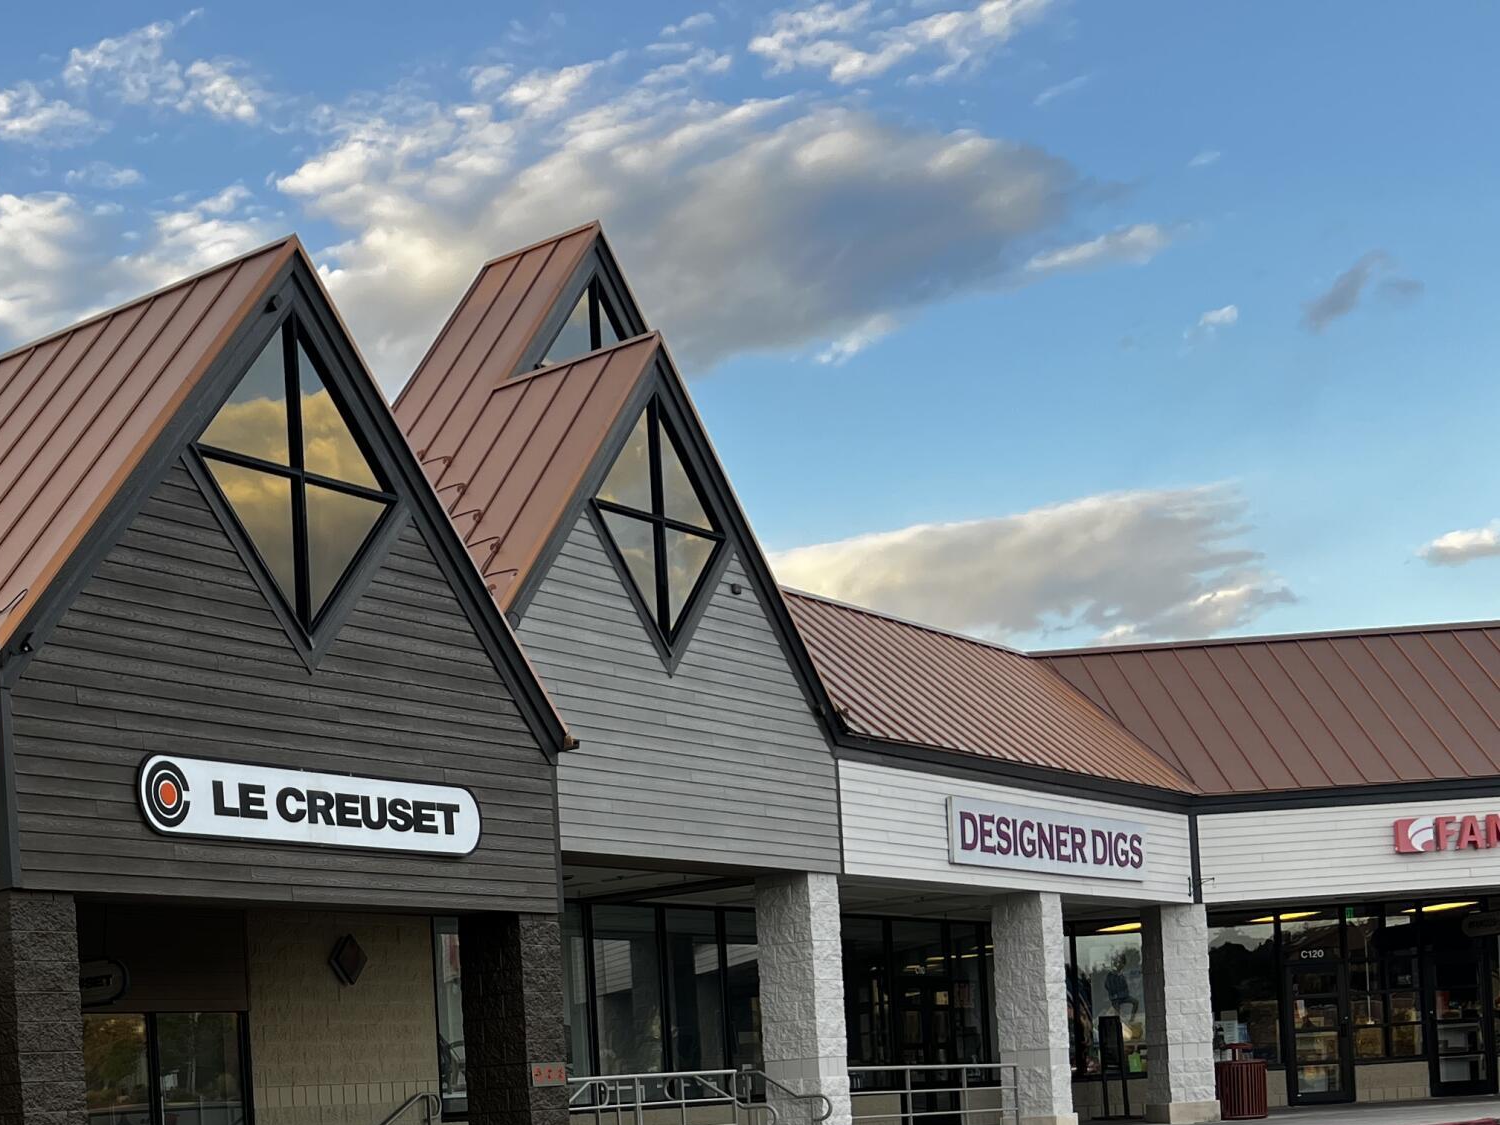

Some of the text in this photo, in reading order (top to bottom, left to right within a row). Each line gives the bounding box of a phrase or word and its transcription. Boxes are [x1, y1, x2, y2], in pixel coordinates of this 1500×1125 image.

[211, 779, 461, 836] LE CREUSET
[959, 810, 1144, 870] DESIGNER DIGS
[1300, 949, 1325, 959] C120
